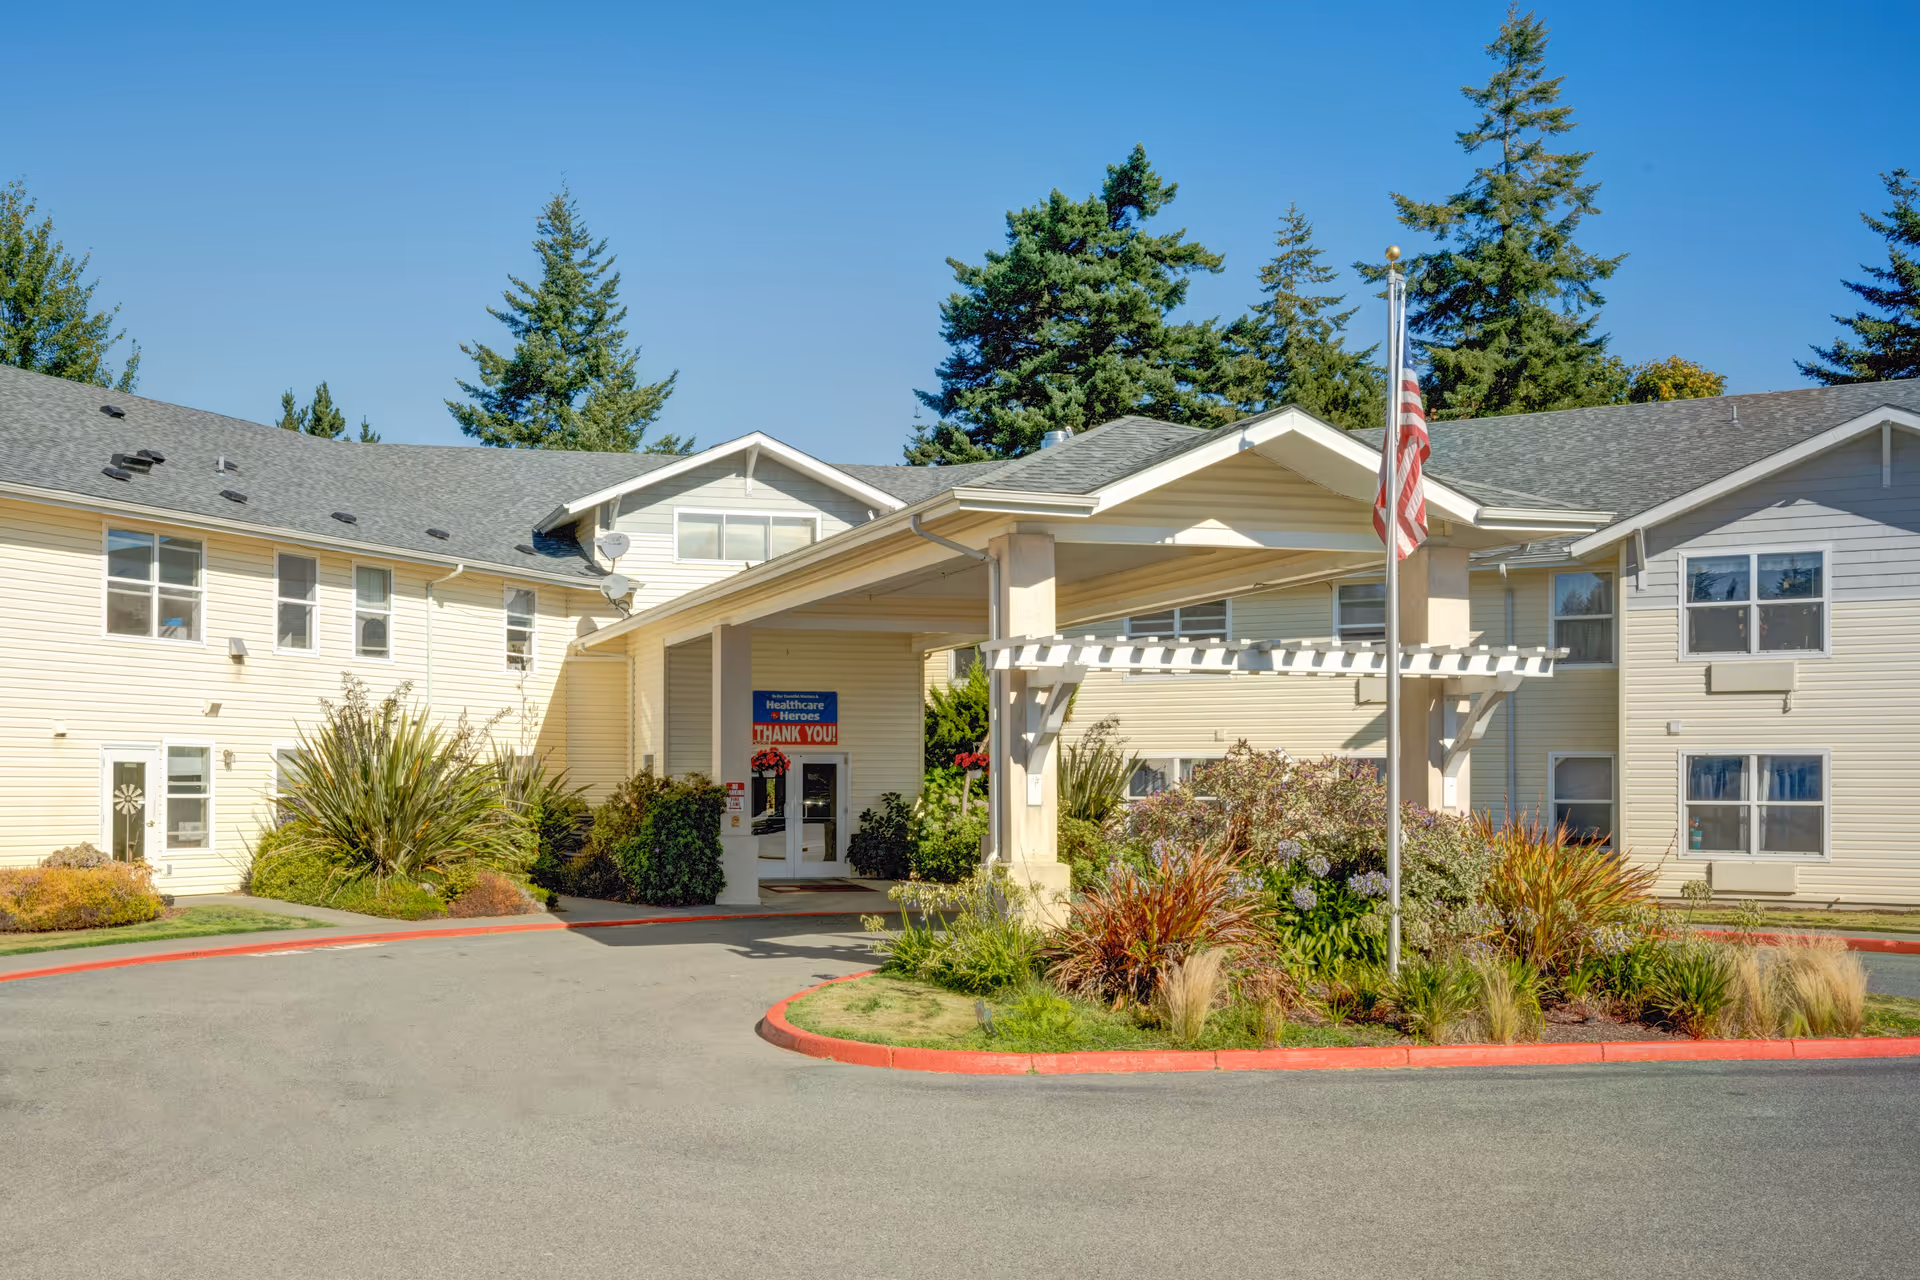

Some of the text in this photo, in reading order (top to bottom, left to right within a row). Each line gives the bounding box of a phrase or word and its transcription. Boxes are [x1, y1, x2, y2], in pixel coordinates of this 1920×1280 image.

[766, 700, 824, 710] Healthcare
[780, 711, 820, 720] Heroes
[754, 725, 836, 742] THANK YOU!
